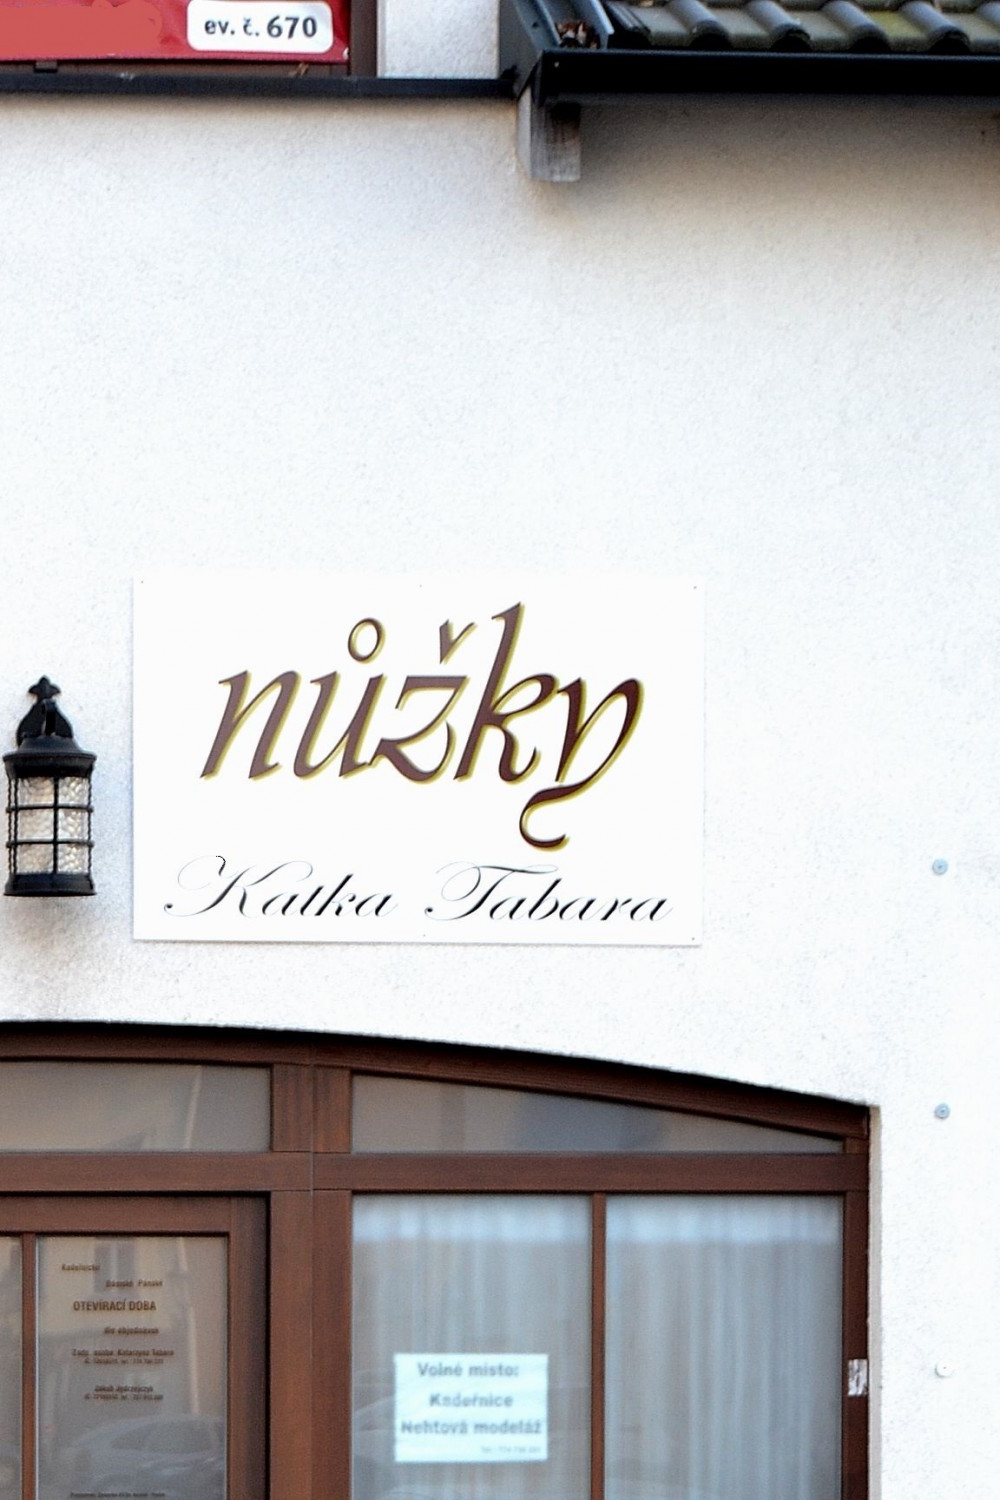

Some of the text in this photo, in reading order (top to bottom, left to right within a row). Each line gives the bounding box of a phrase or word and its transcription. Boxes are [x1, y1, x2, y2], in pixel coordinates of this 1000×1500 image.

[204, 15, 318, 39] ev. č. 670
[200, 601, 644, 852] nůžky
[164, 855, 674, 922] Katka Tabara
[73, 1299, 157, 1311] OTEVÍRACÍ DOBA
[417, 1362, 463, 1377] Volné
